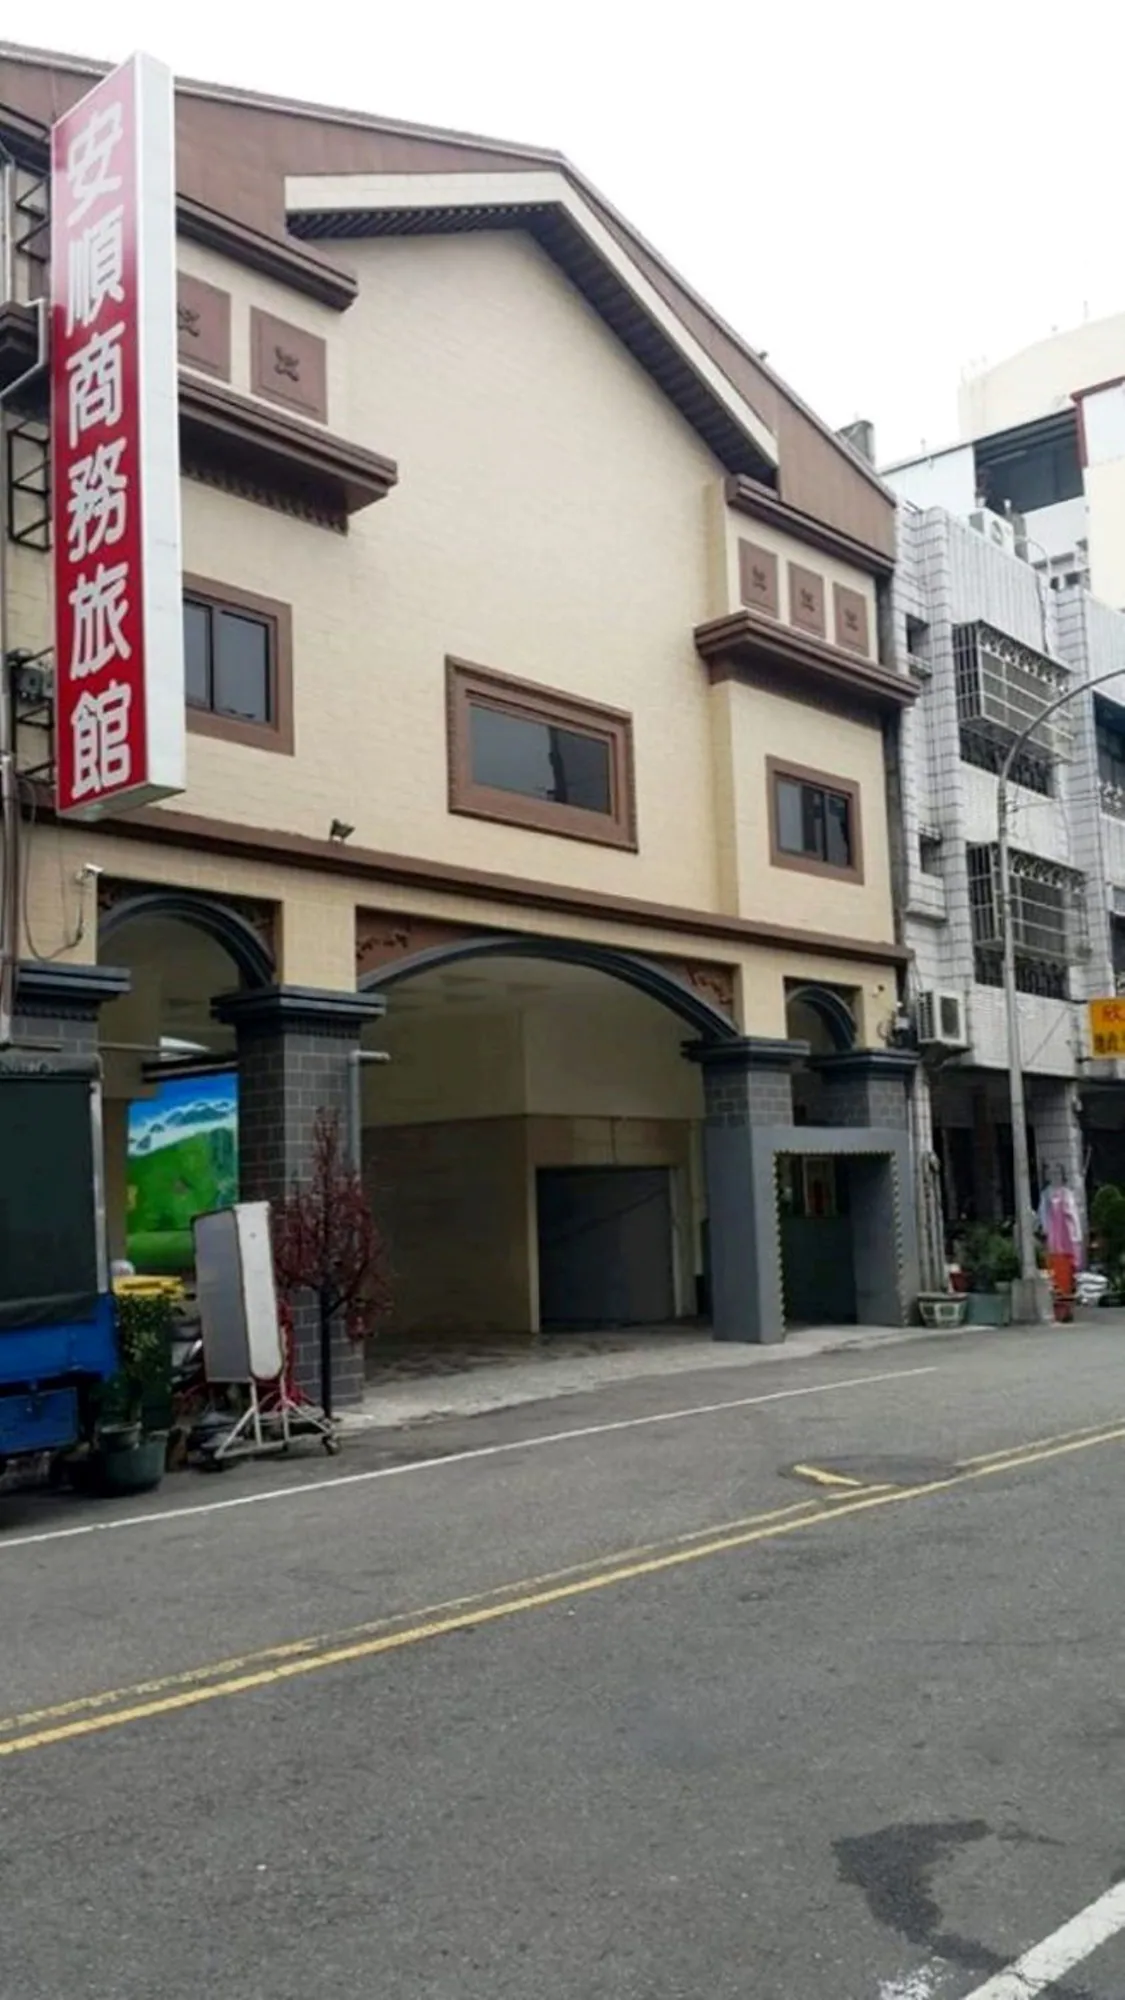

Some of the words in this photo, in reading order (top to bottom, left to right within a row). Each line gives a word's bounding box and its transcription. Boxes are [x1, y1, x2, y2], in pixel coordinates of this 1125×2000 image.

[67, 101, 132, 800] 安順商務旅館
